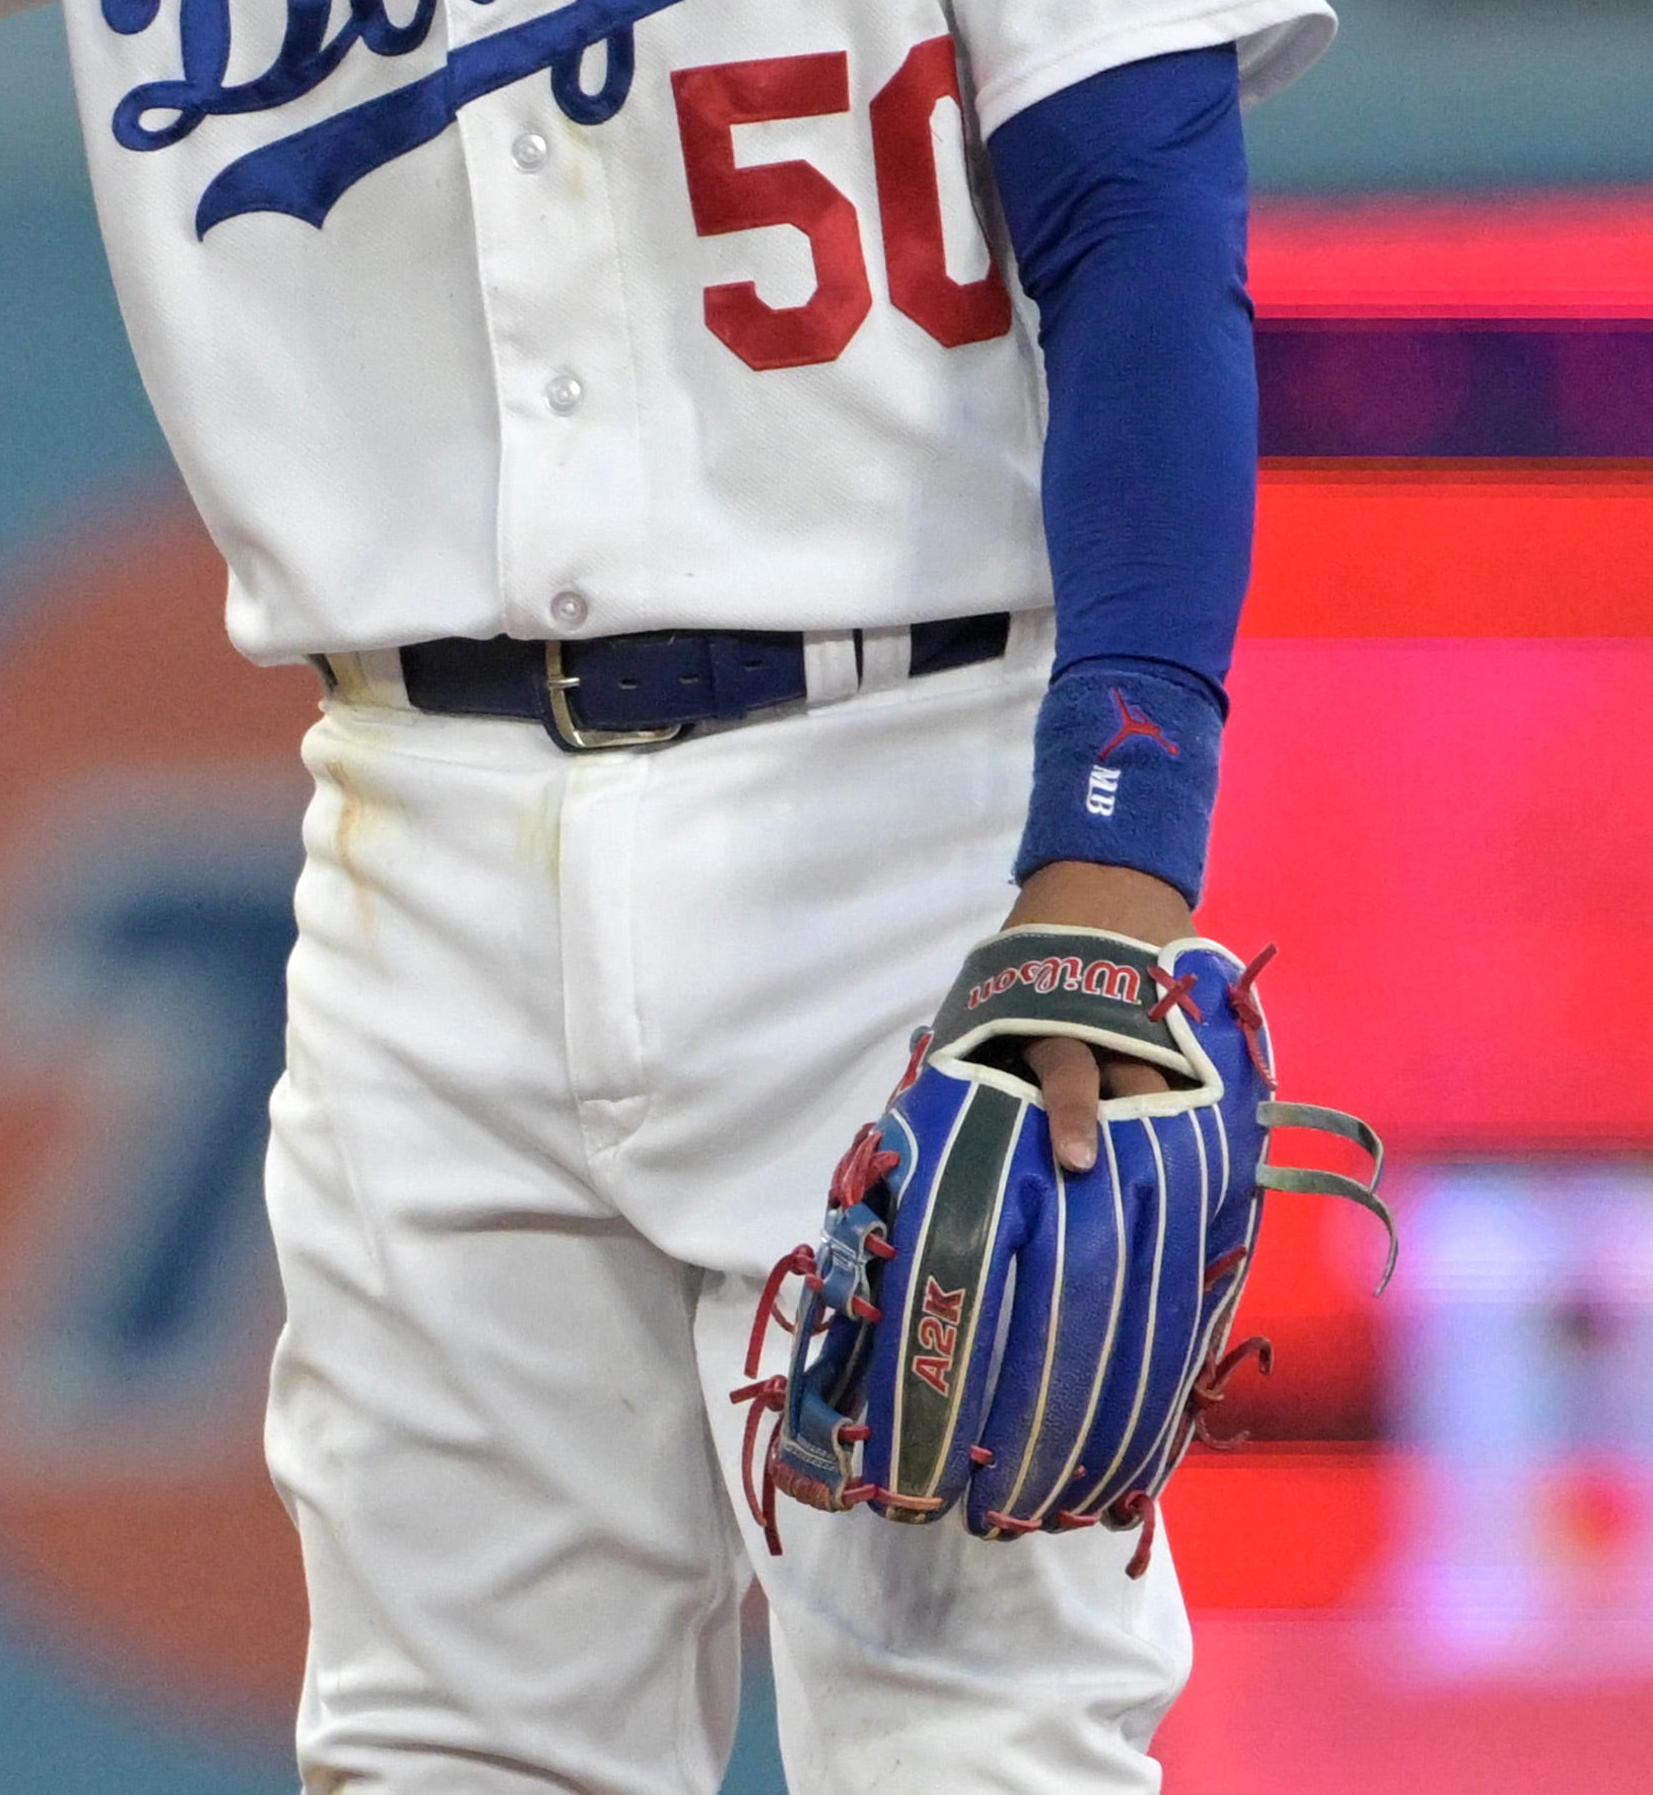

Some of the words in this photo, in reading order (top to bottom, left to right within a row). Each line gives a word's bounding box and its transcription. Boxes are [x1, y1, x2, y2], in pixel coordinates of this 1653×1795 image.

[670, 35, 1013, 372] 50
[1086, 764, 1121, 817] MB
[967, 956, 1143, 1010] Wilson
[911, 1274, 966, 1398] A2K
